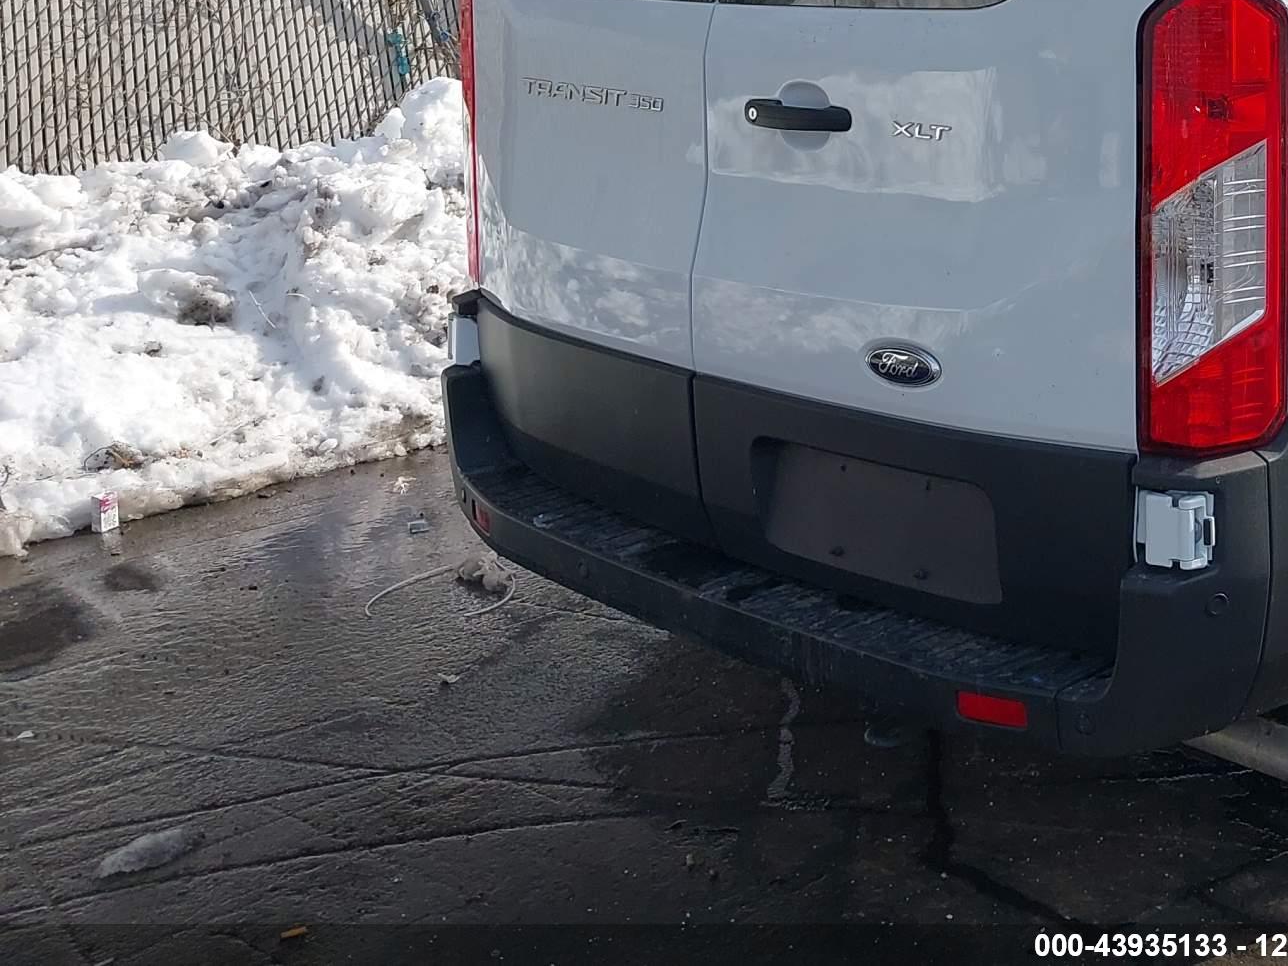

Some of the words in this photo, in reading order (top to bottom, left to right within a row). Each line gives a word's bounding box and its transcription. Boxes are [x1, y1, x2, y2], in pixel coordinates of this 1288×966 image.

[521, 77, 627, 107] TRANSIT
[627, 94, 665, 113] 350
[892, 120, 953, 141] XLT
[878, 352, 919, 378] Ford
